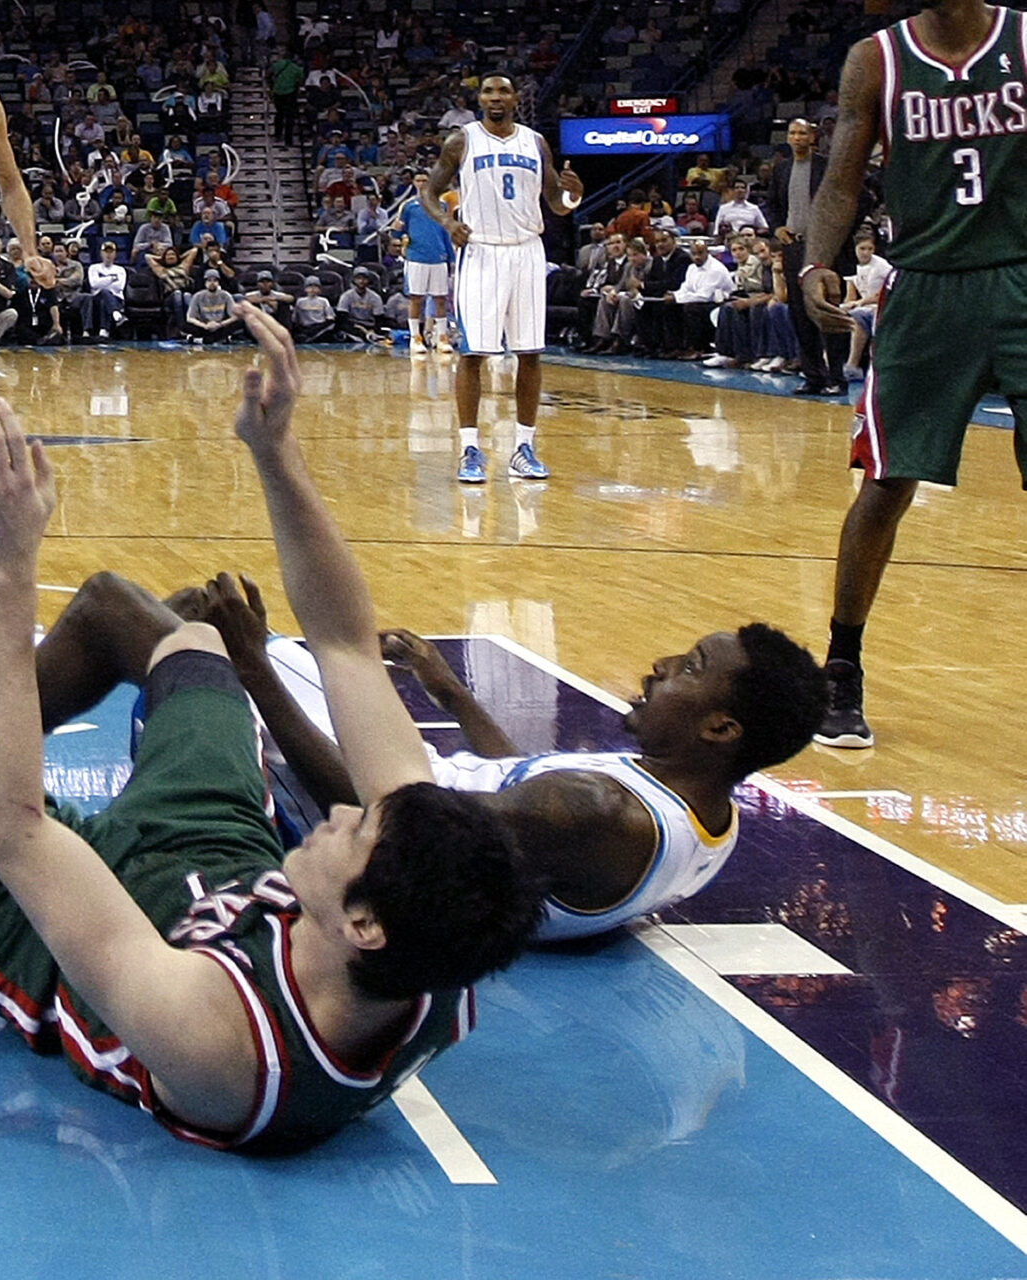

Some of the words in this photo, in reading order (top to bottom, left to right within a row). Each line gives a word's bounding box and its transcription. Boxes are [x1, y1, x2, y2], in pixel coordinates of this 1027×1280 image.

[901, 81, 1027, 140] BUCKS
[473, 154, 494, 173] NEW
[498, 153, 538, 175] ORLEANS
[953, 148, 983, 205] 3
[502, 173, 515, 199] 8
